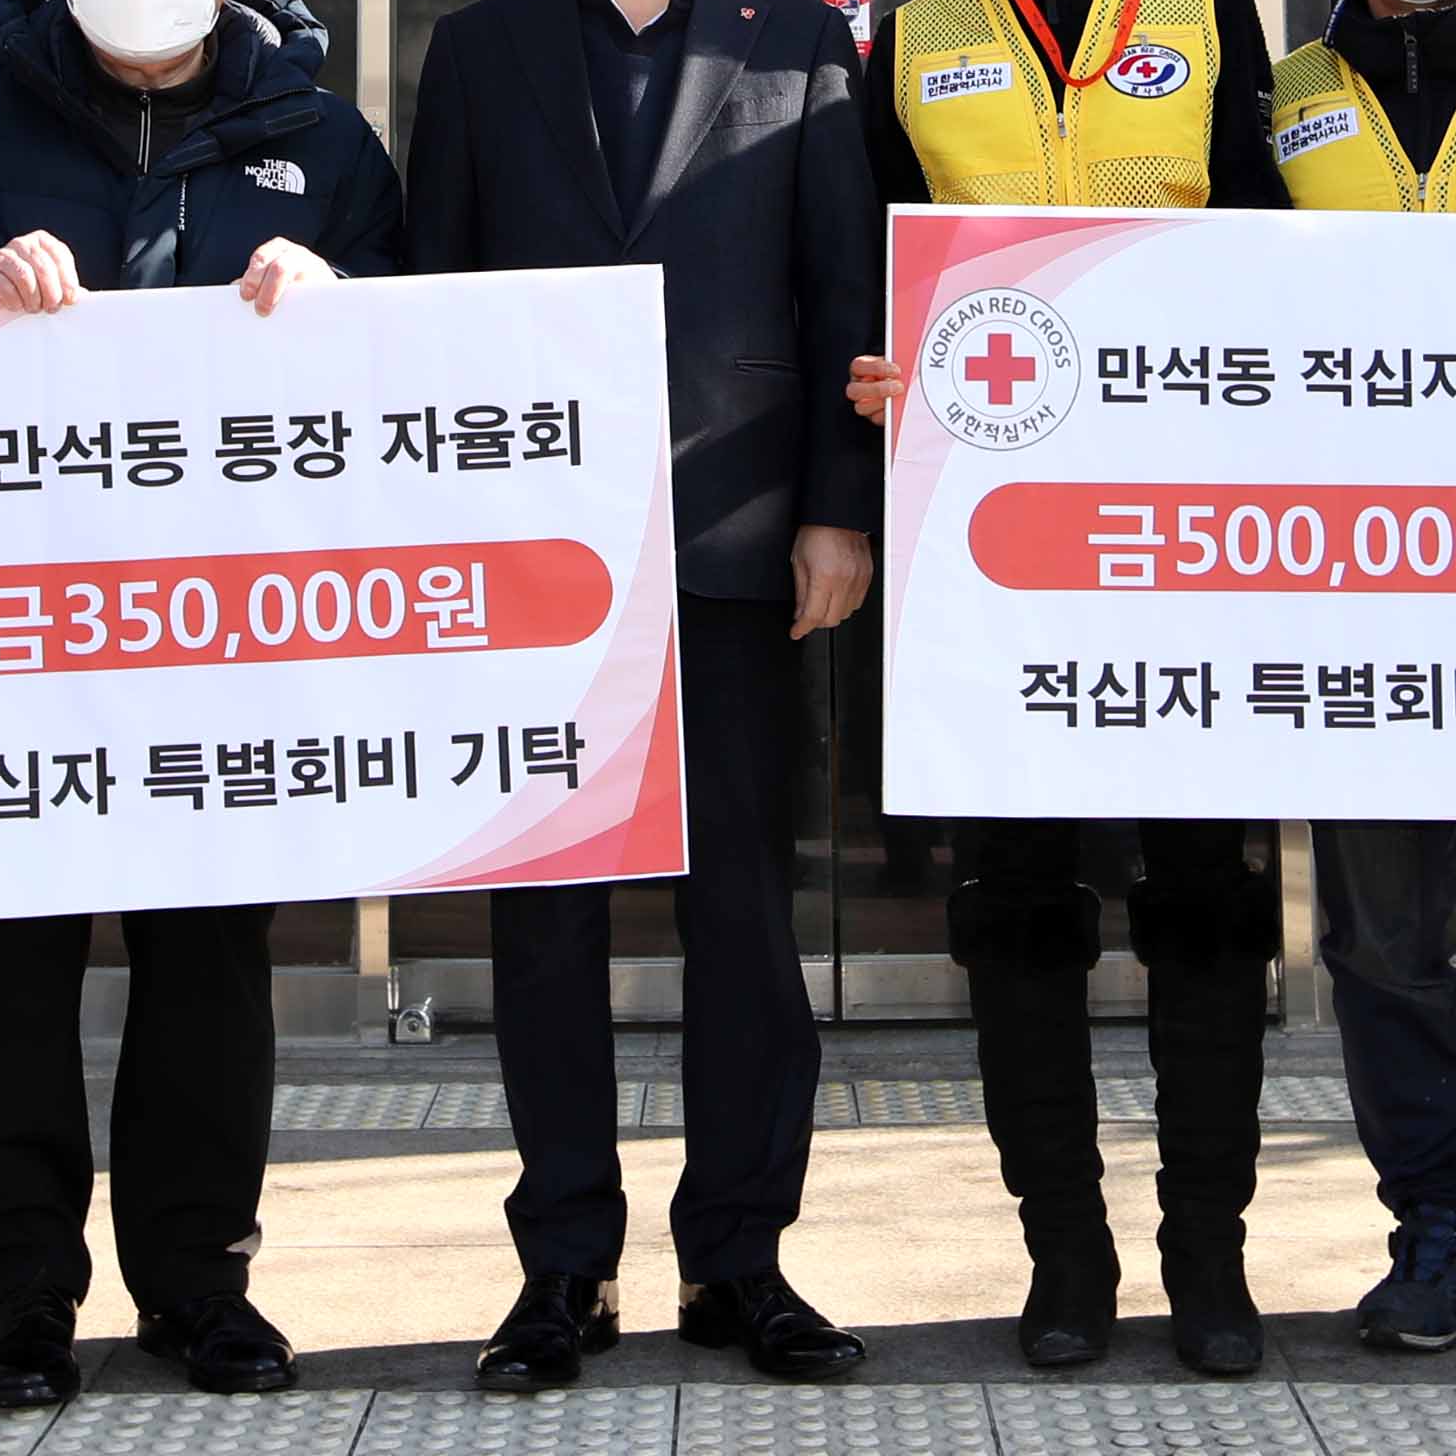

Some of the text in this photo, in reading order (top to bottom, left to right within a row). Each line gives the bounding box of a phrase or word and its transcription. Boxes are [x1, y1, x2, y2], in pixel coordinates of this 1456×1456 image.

[244, 165, 285, 181] NORTH
[256, 176, 285, 191] FACE
[263, 158, 286, 170] THE
[929, 296, 1072, 369] KOREAN RED CROSS
[1097, 345, 1275, 407] 만석동
[215, 410, 352, 482] 통장
[381, 399, 582, 474] 자율회
[946, 402, 1057, 443] 대한적십자사
[1020, 660, 1220, 730] 적십자
[142, 730, 419, 810] 특별회비
[450, 721, 586, 794] 기탁
